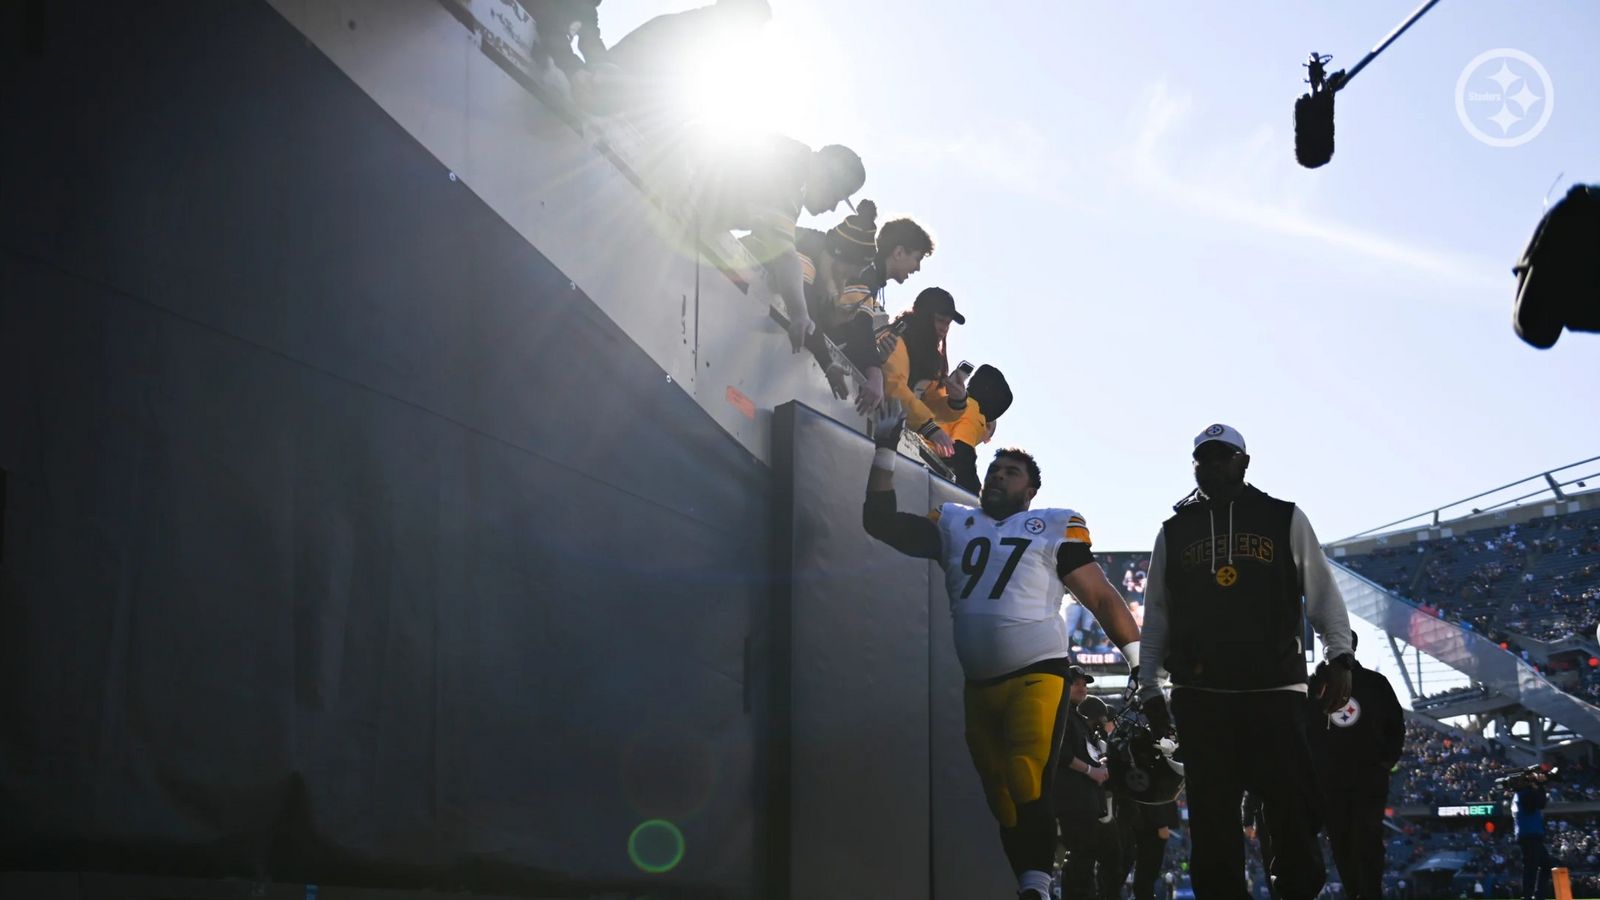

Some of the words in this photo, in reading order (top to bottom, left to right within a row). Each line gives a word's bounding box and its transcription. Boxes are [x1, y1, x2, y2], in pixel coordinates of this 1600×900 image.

[1182, 532, 1274, 566] STEELERS
[960, 536, 1032, 600] 97
[1469, 805, 1494, 815] BET
